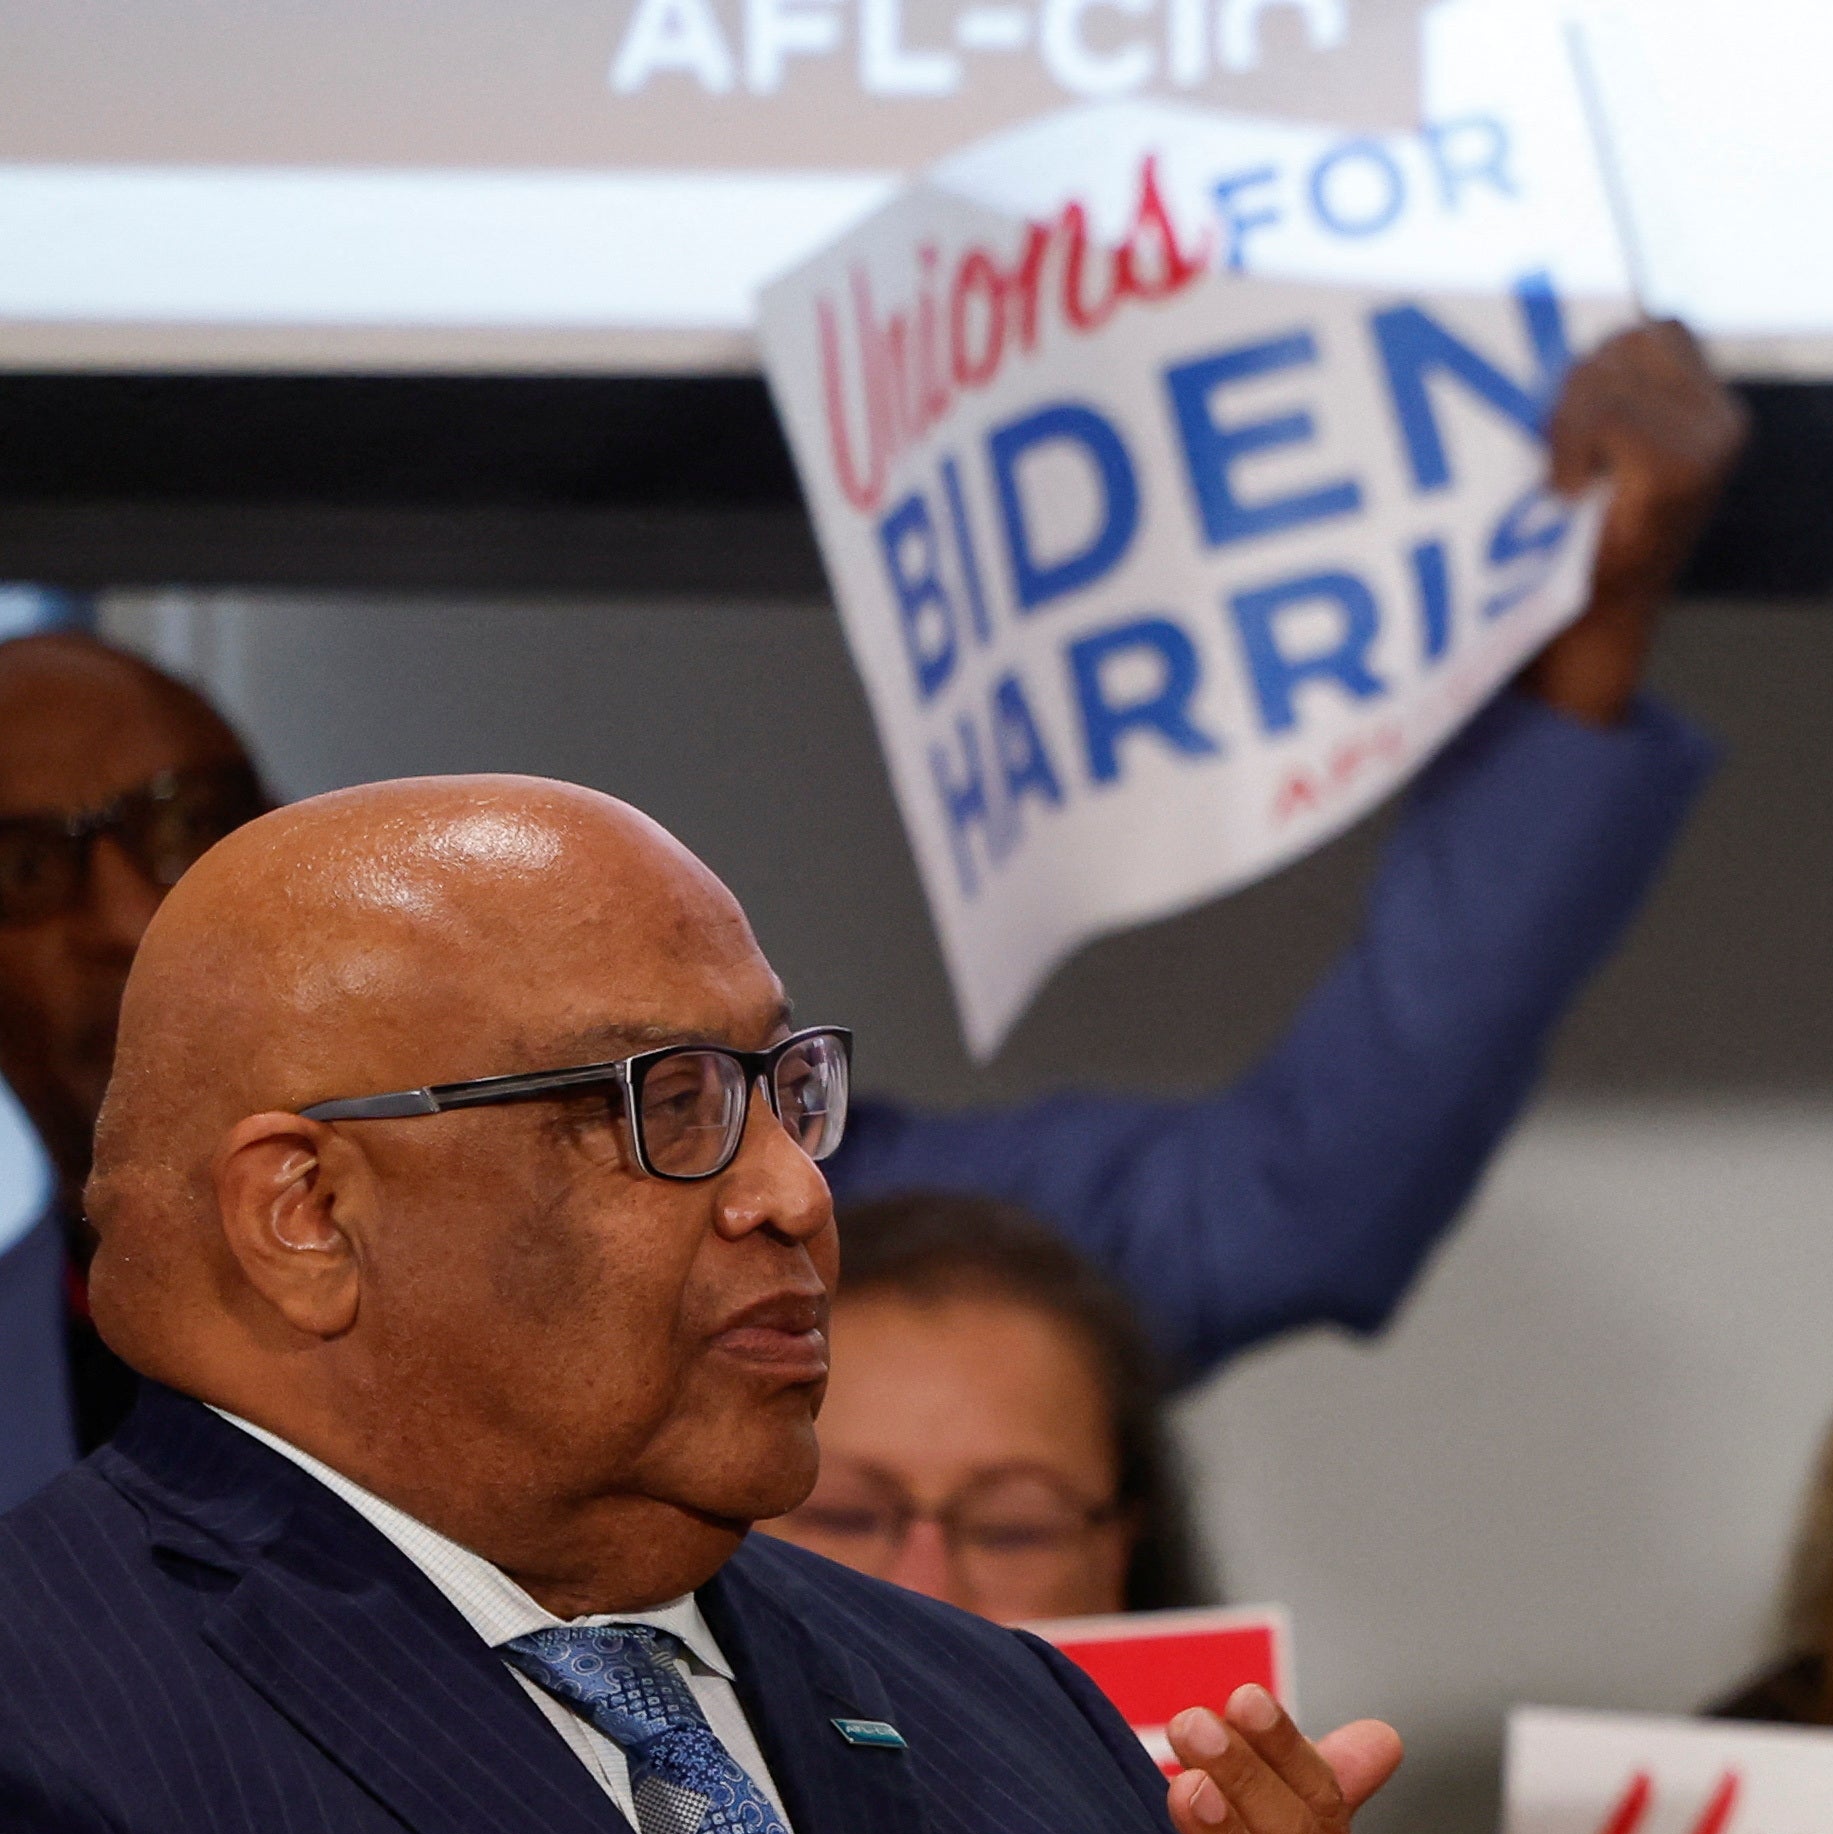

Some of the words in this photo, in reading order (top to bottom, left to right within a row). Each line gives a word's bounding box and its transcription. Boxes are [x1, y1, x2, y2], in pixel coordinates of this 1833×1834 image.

[813, 150, 1214, 515] Unions
[1213, 112, 1522, 273] FOR
[878, 270, 1577, 706] BIDEN
[930, 485, 1571, 900] HARRIS
